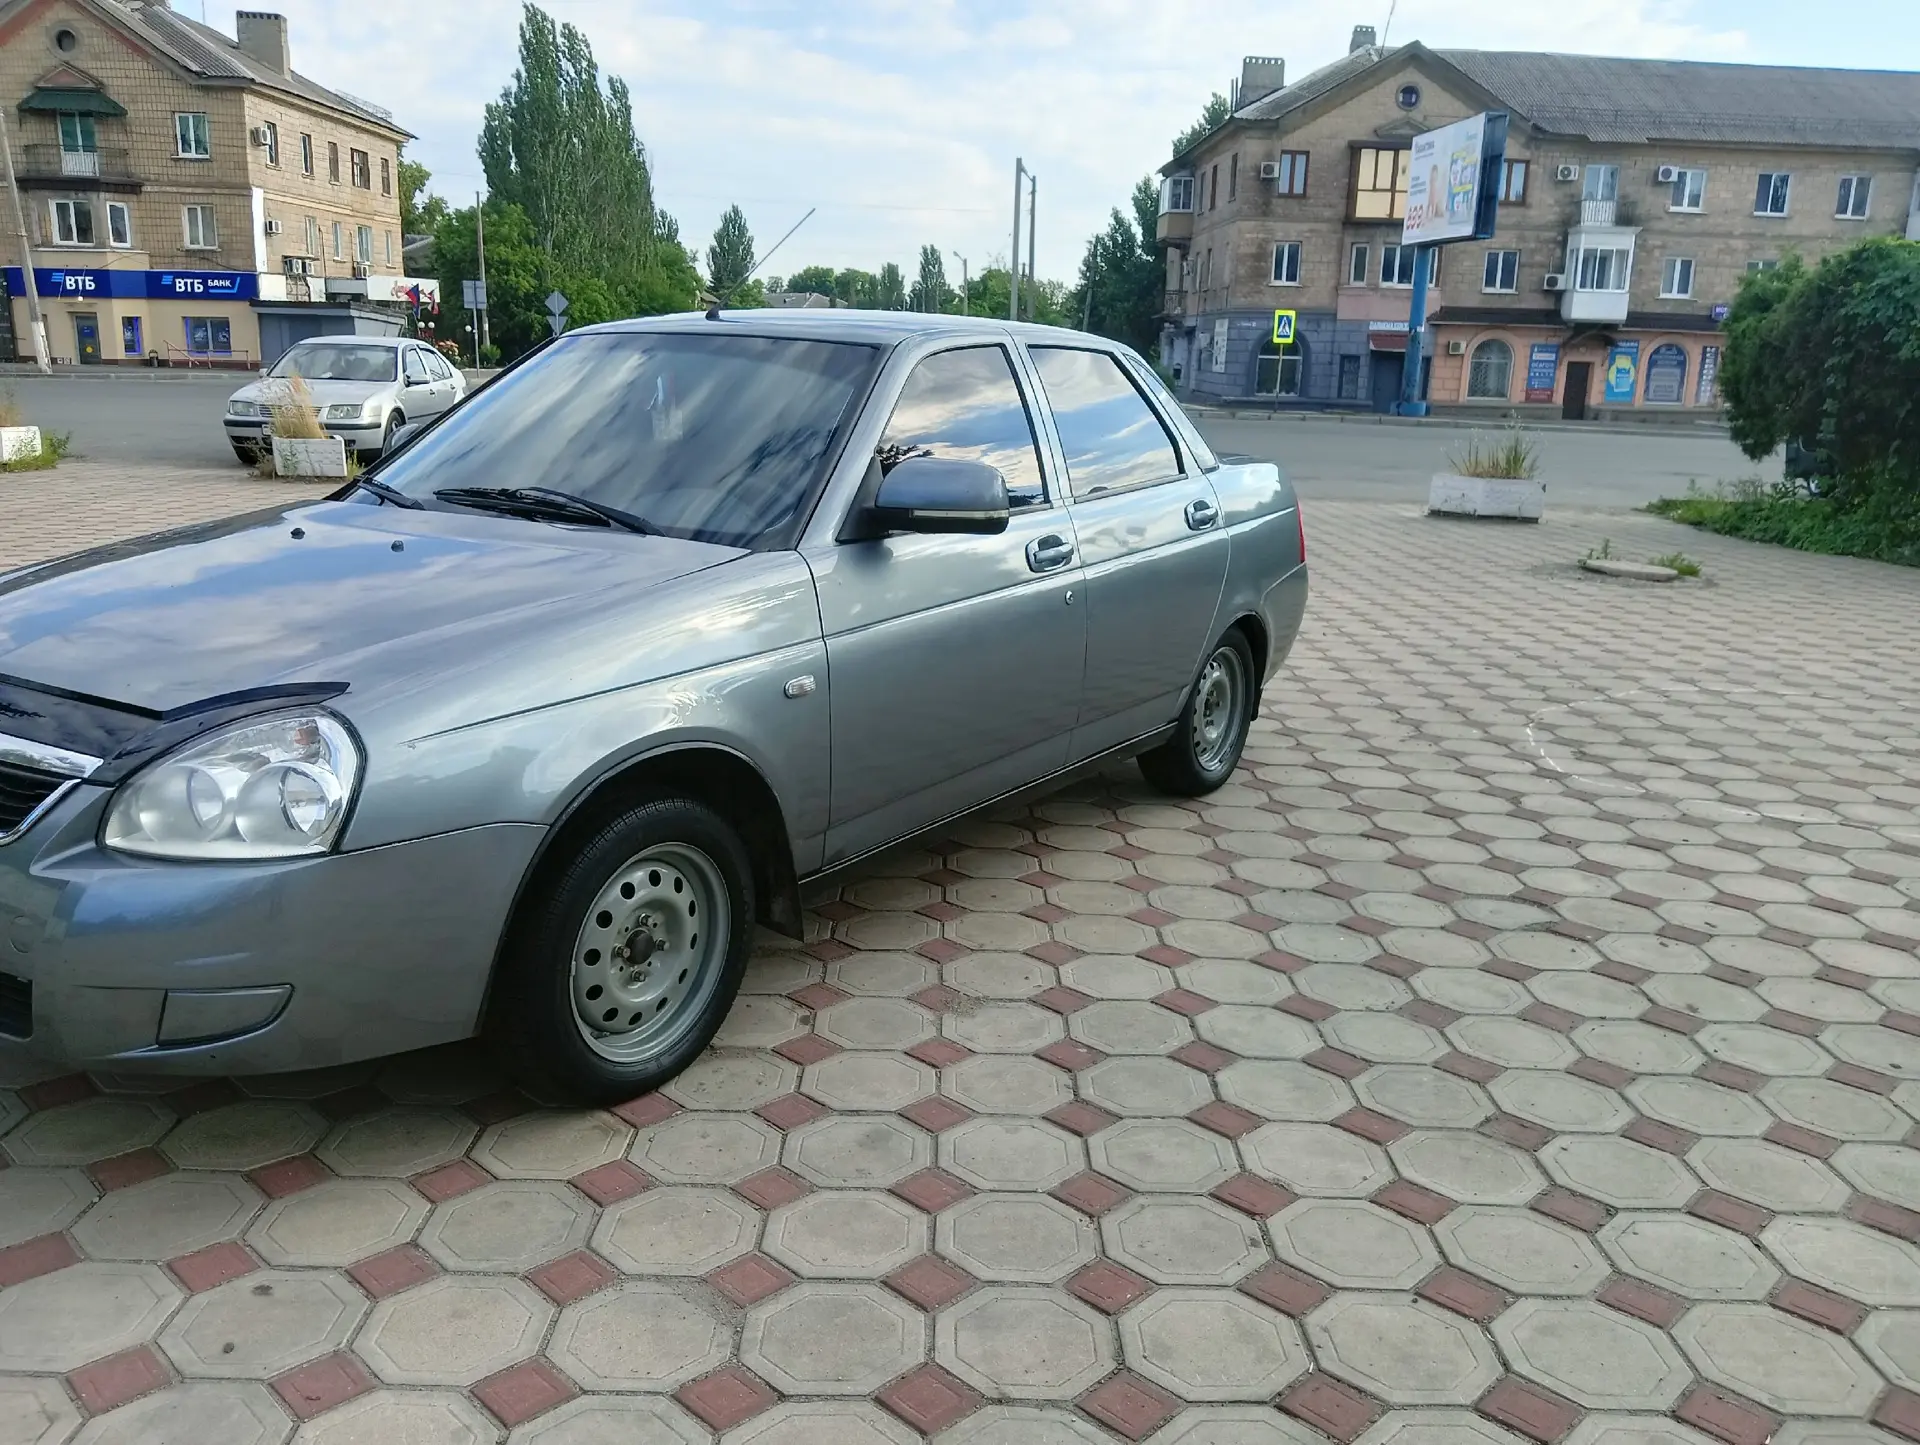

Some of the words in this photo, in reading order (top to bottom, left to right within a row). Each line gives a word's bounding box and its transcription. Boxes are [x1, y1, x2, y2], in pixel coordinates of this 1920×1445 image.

[65, 275, 96, 290] ВТБ
[174, 278, 205, 293] ВТБ
[207, 279, 232, 288] БАНК
